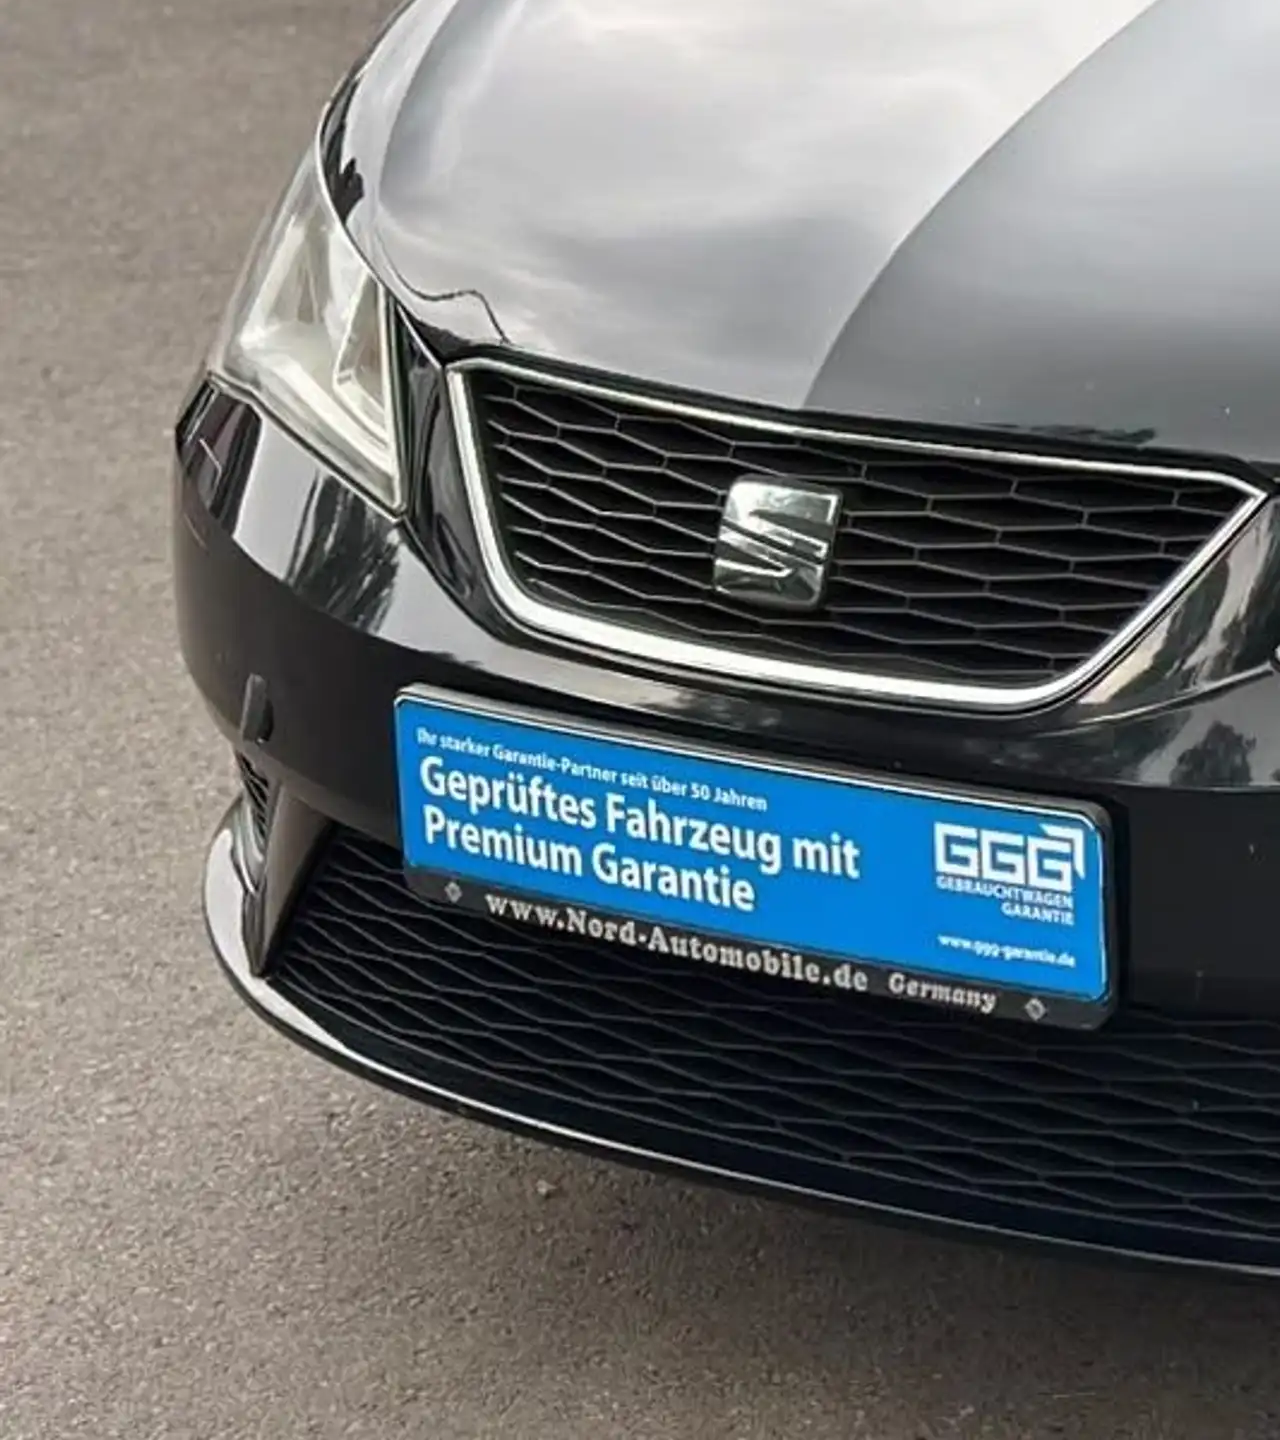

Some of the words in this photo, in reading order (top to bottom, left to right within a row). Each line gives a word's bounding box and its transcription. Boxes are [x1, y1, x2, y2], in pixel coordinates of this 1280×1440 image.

[415, 726, 438, 747] Ihr
[440, 735, 490, 758] starker
[492, 745, 617, 783] Garantie-Partner
[621, 772, 649, 790] seit
[651, 776, 688, 797] über
[691, 782, 711, 801] 50
[713, 786, 768, 812] Jahren
[420, 755, 597, 829] Geprüftes
[605, 792, 781, 876] Fahrzeug
[792, 831, 860, 879] mit
[423, 803, 583, 877] Premium
[592, 841, 755, 912] Garantie
[936, 875, 1074, 910] GEBRAUCHTWAGEN
[1001, 901, 1075, 926] GARANTIE
[889, 972, 997, 1014] Germany
